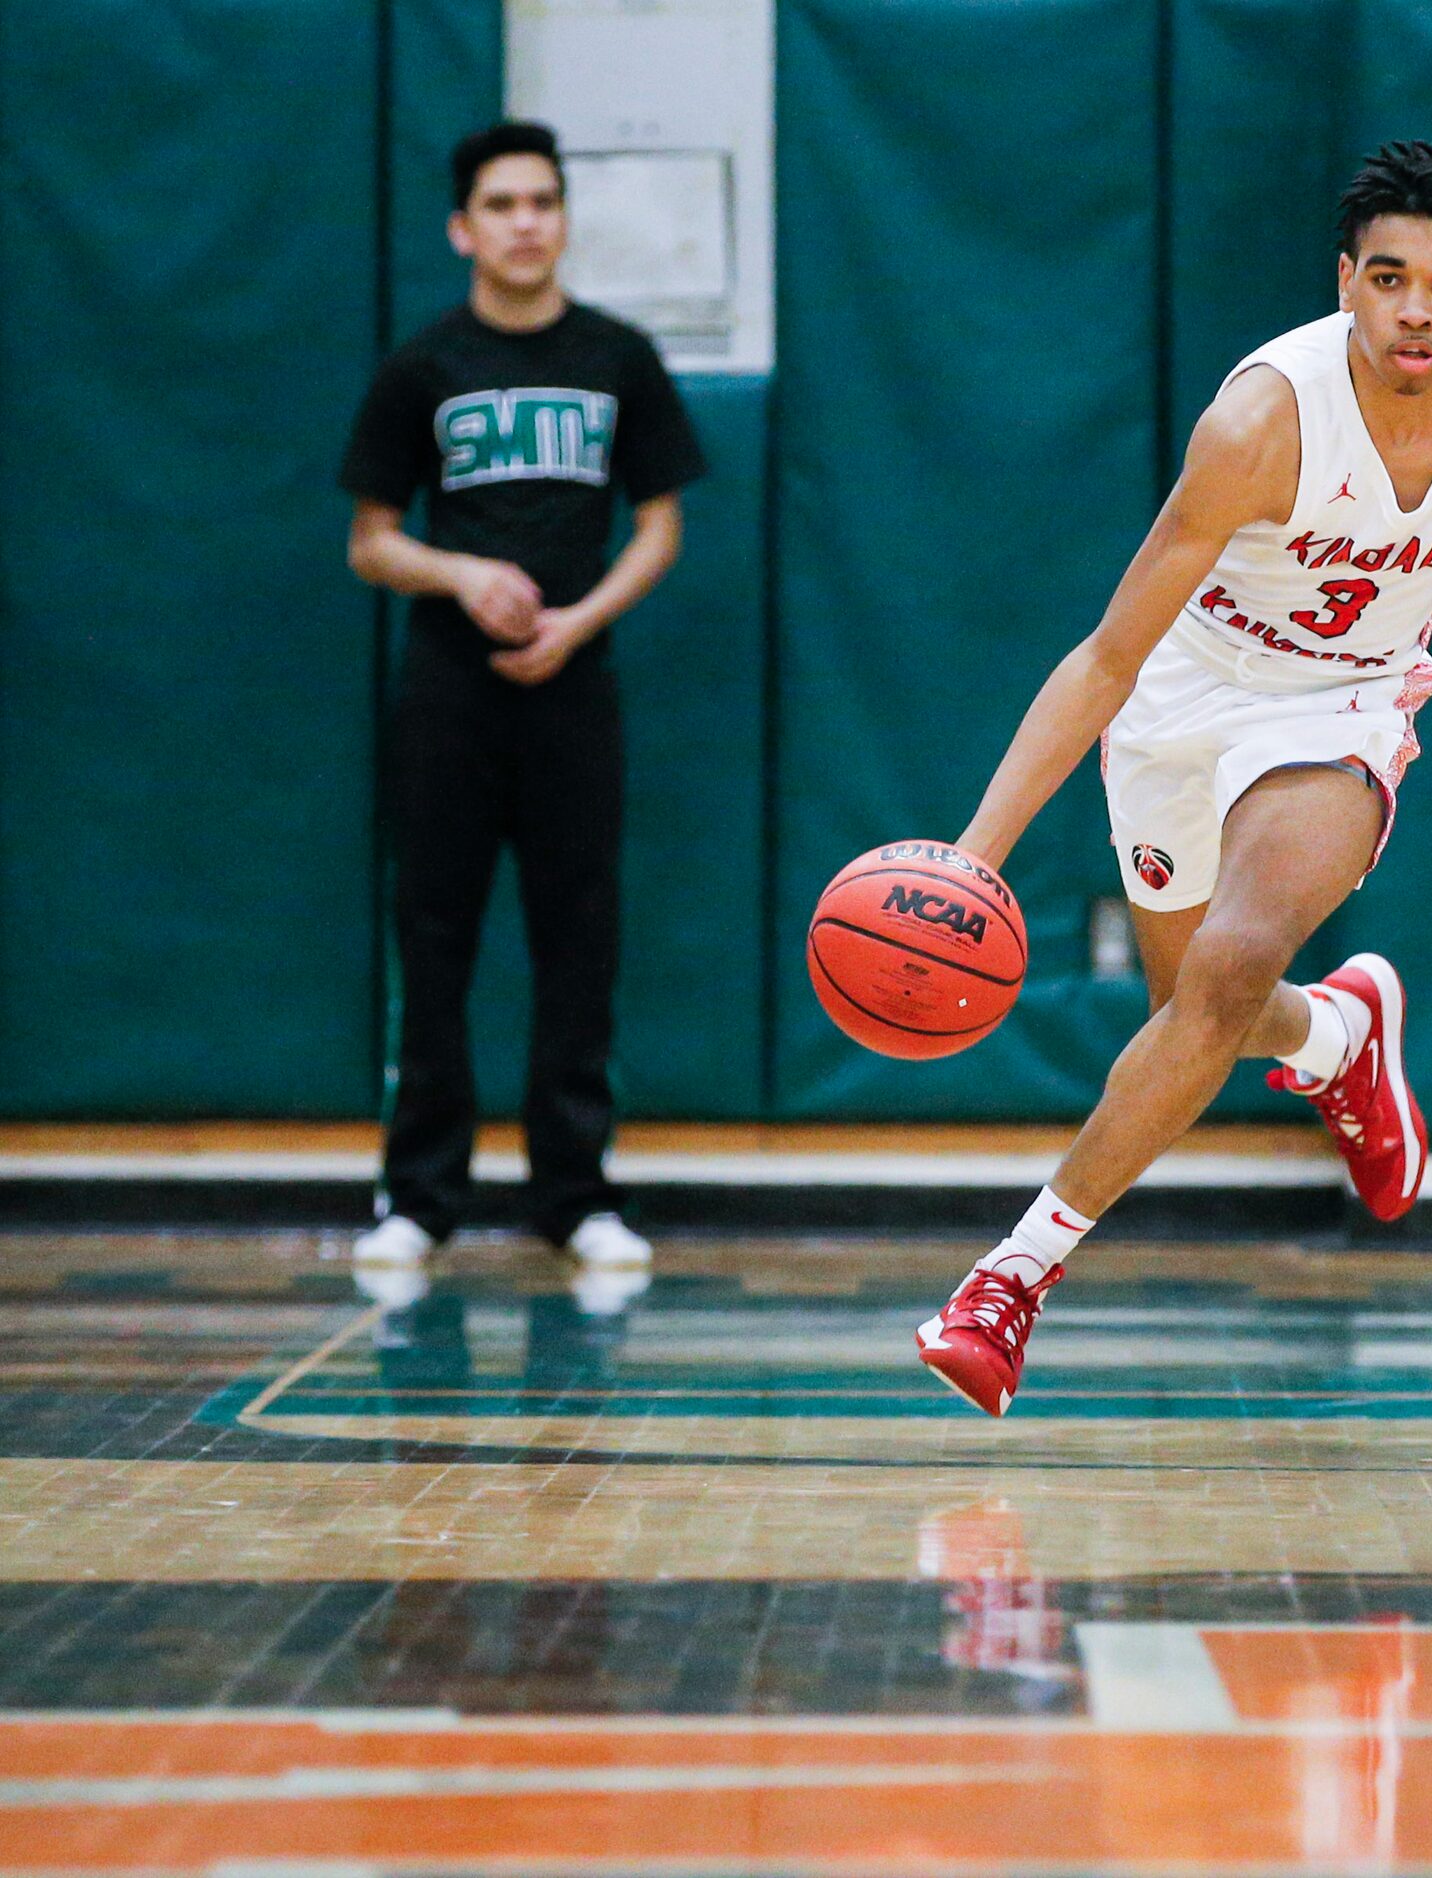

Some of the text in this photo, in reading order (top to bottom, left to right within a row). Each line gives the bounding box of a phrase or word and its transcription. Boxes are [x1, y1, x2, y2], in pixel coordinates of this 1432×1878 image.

[436, 388, 617, 490] SMITH
[1289, 578, 1380, 640] 3
[881, 884, 988, 944] NCAA
